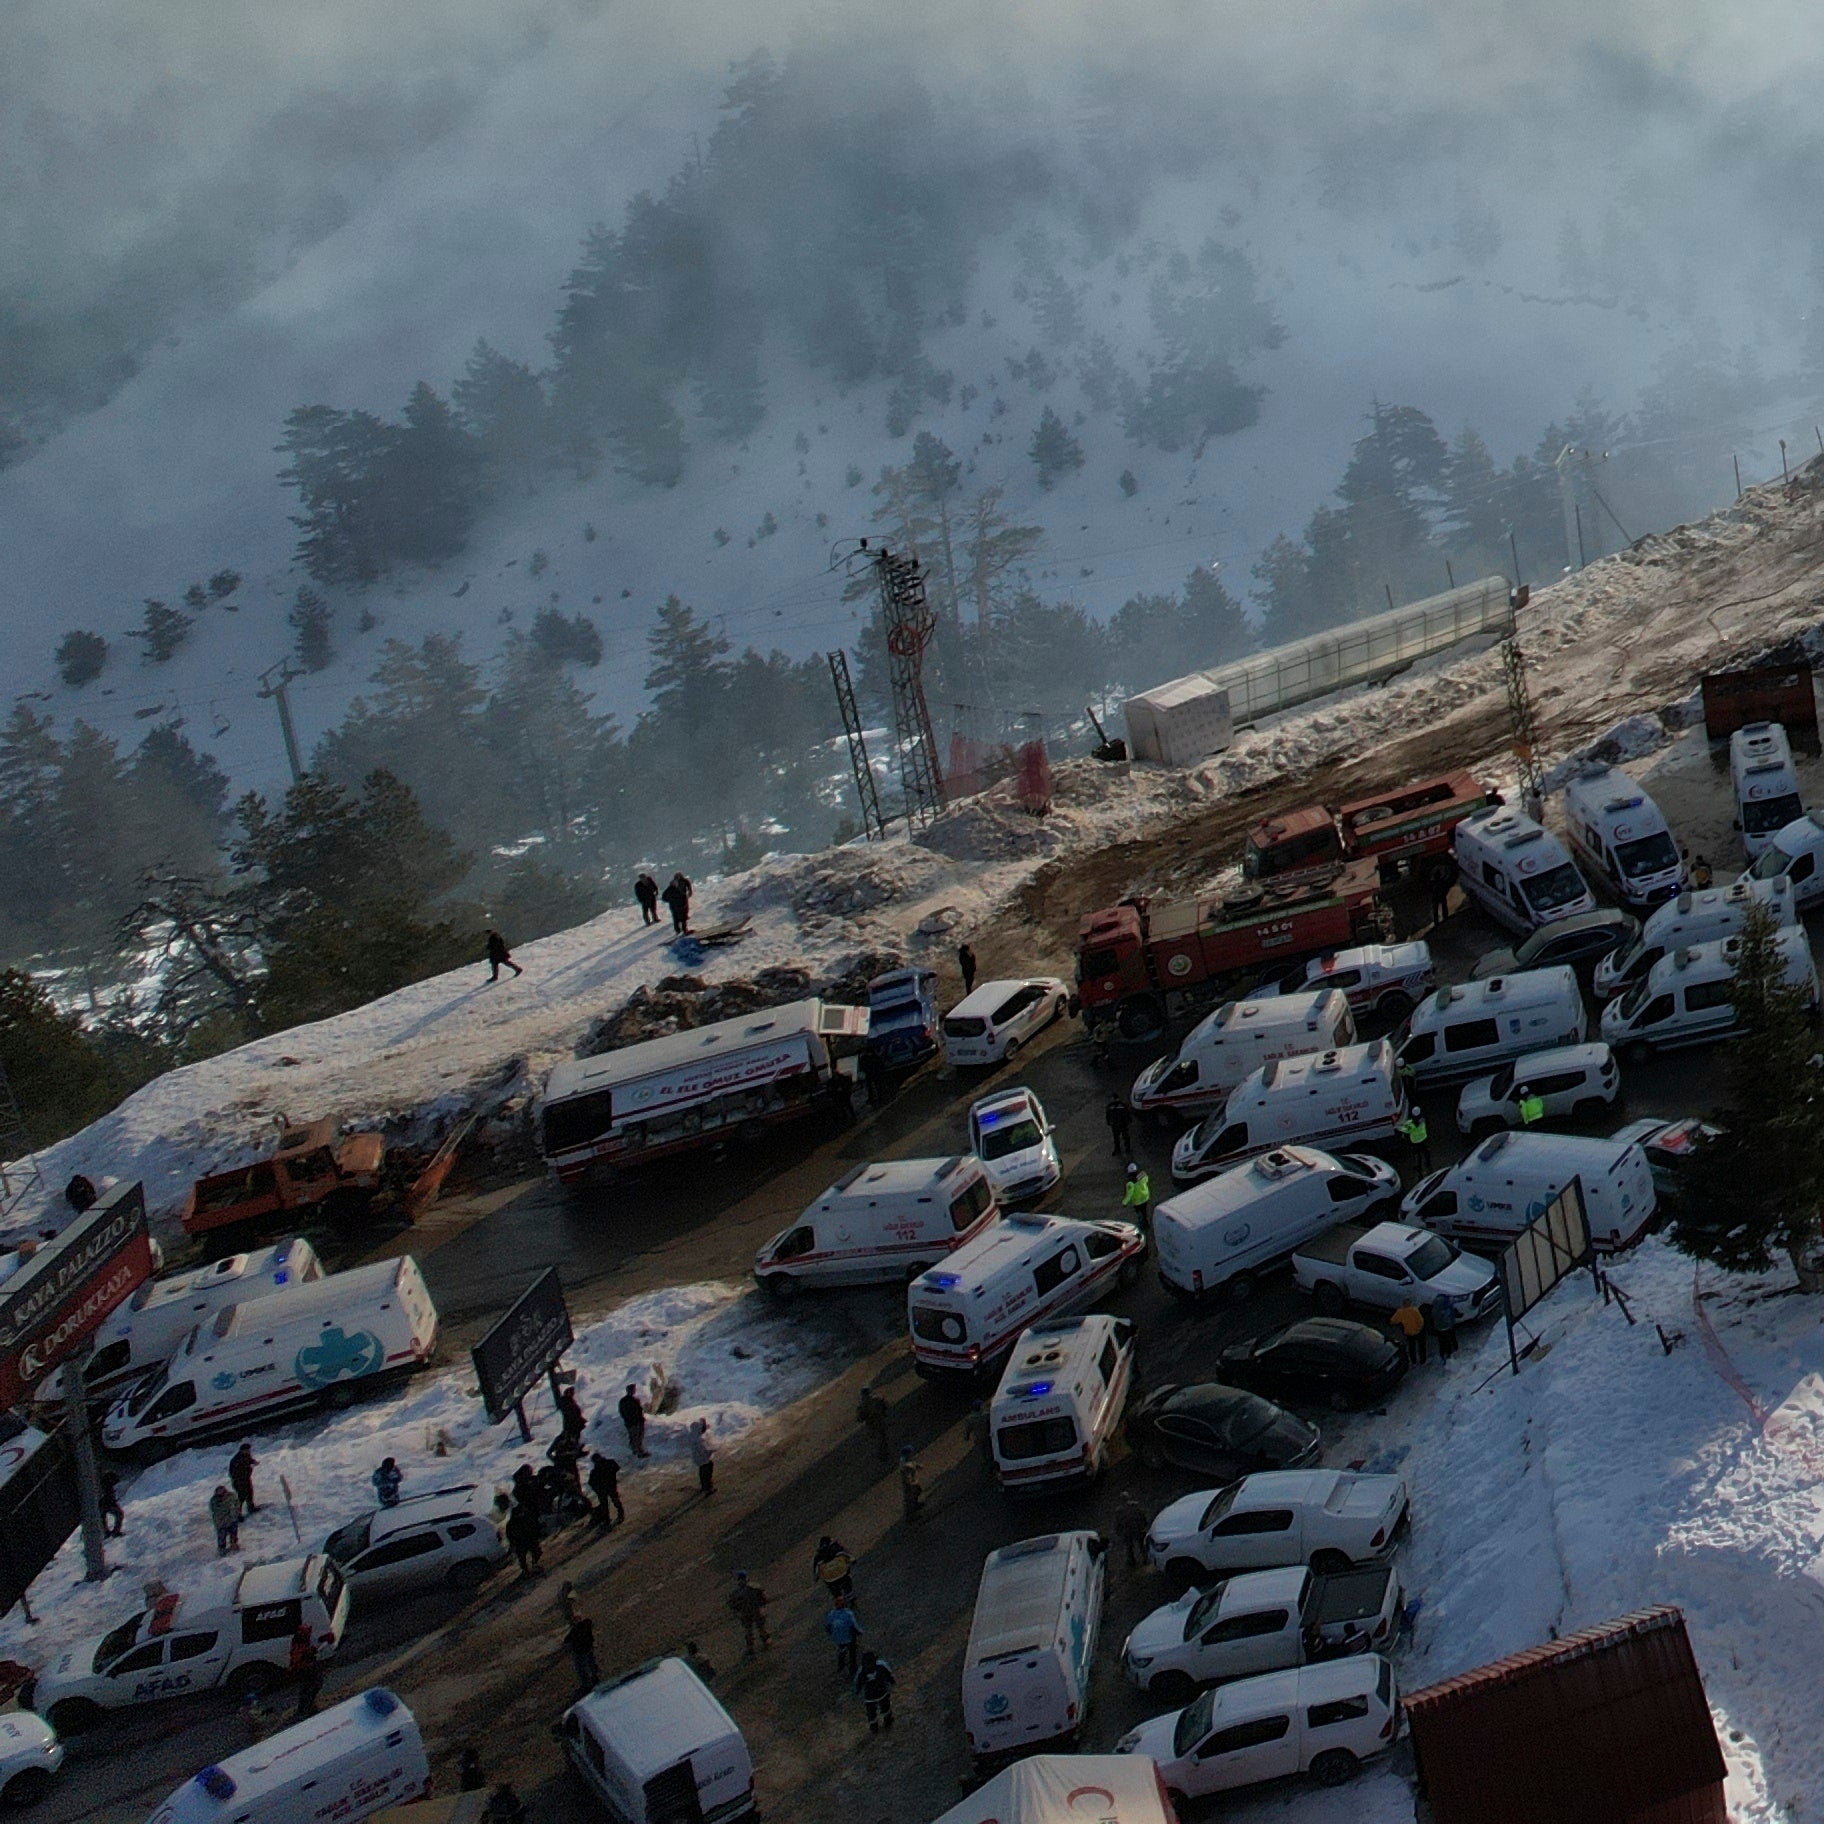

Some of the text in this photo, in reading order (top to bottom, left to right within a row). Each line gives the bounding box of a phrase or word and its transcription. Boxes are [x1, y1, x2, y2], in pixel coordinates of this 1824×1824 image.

[660, 1085, 672, 1094] EL
[677, 1083, 699, 1094] ELE
[1338, 1111, 1359, 1123] 112
[896, 1230, 916, 1240] 112
[14, 1217, 125, 1327] KAYA PALAZZO
[44, 1266, 132, 1356] DORUKKAYA
[1001, 1406, 1061, 1423] AMBULANS
[133, 1674, 191, 1700] AFAD
